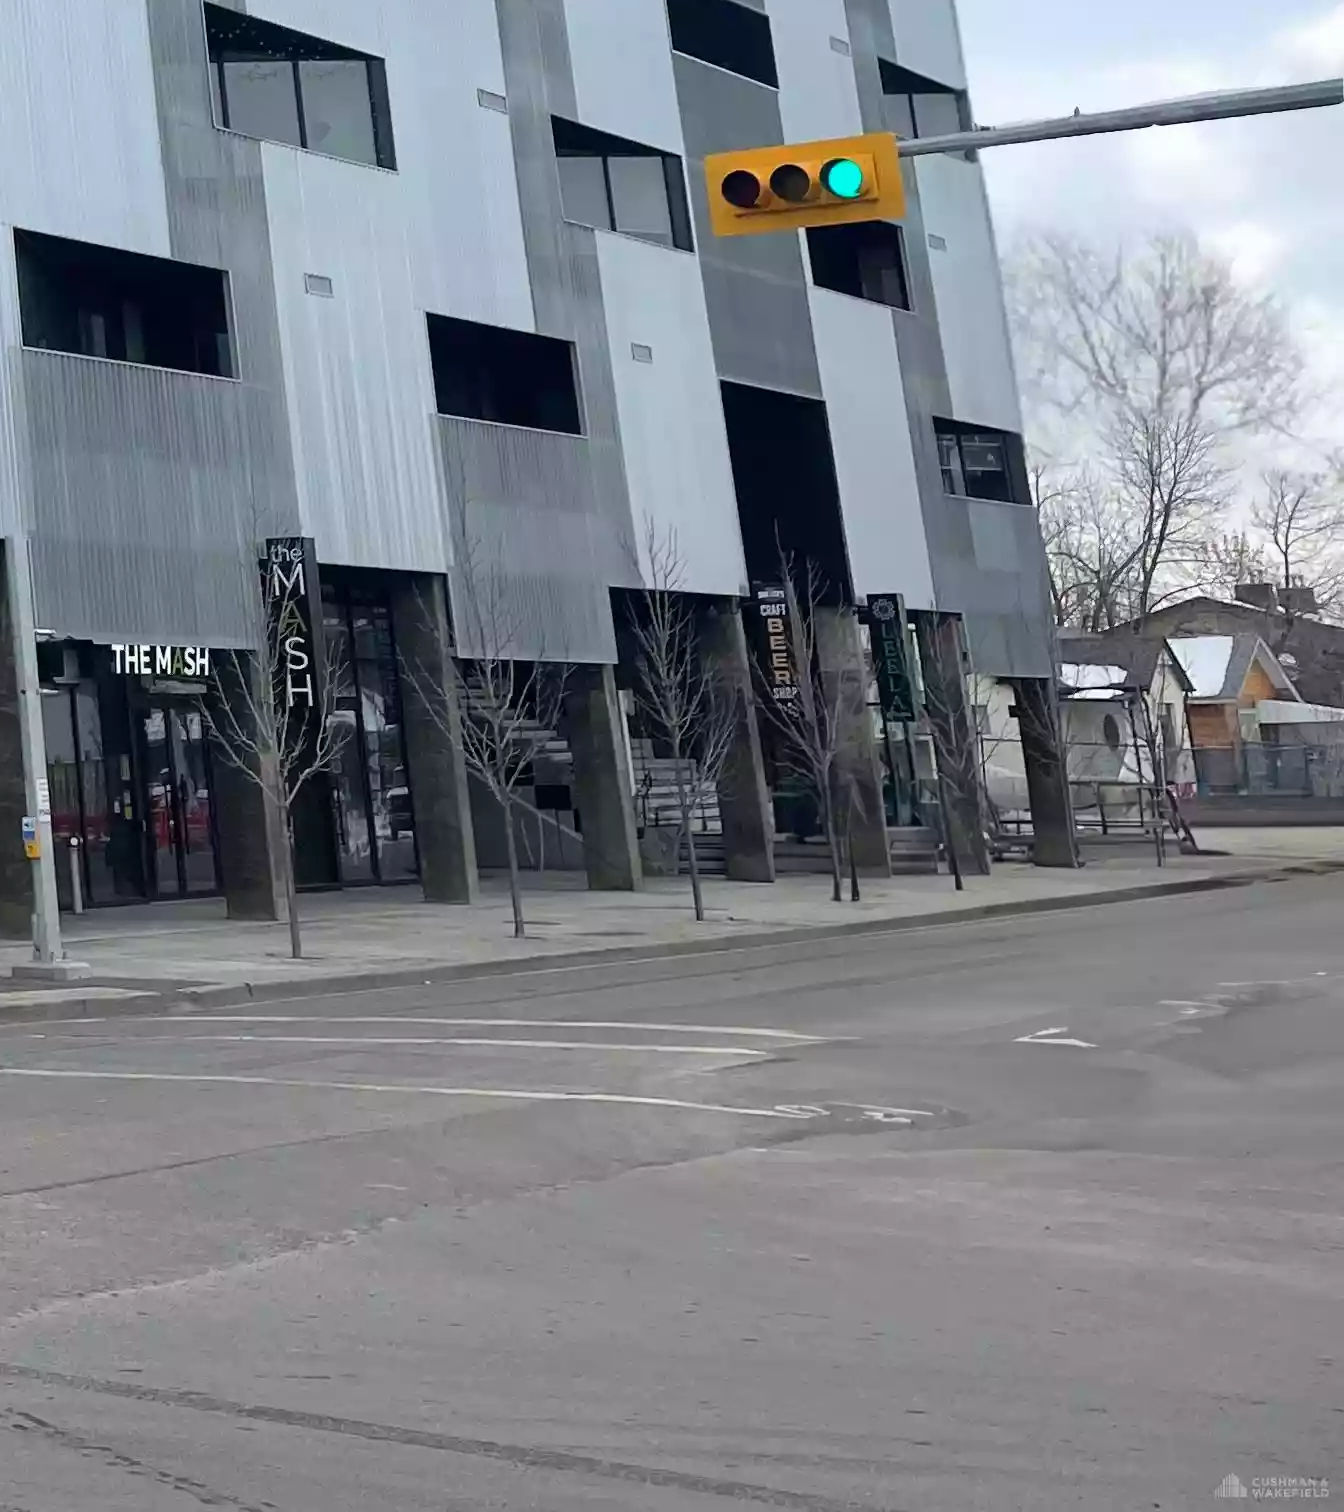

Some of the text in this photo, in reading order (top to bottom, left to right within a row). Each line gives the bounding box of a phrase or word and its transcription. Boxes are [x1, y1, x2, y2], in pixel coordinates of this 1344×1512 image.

[270, 544, 303, 563] the
[271, 563, 314, 707] MASH
[767, 617, 791, 685] BEER
[111, 644, 210, 677] THE MASH
